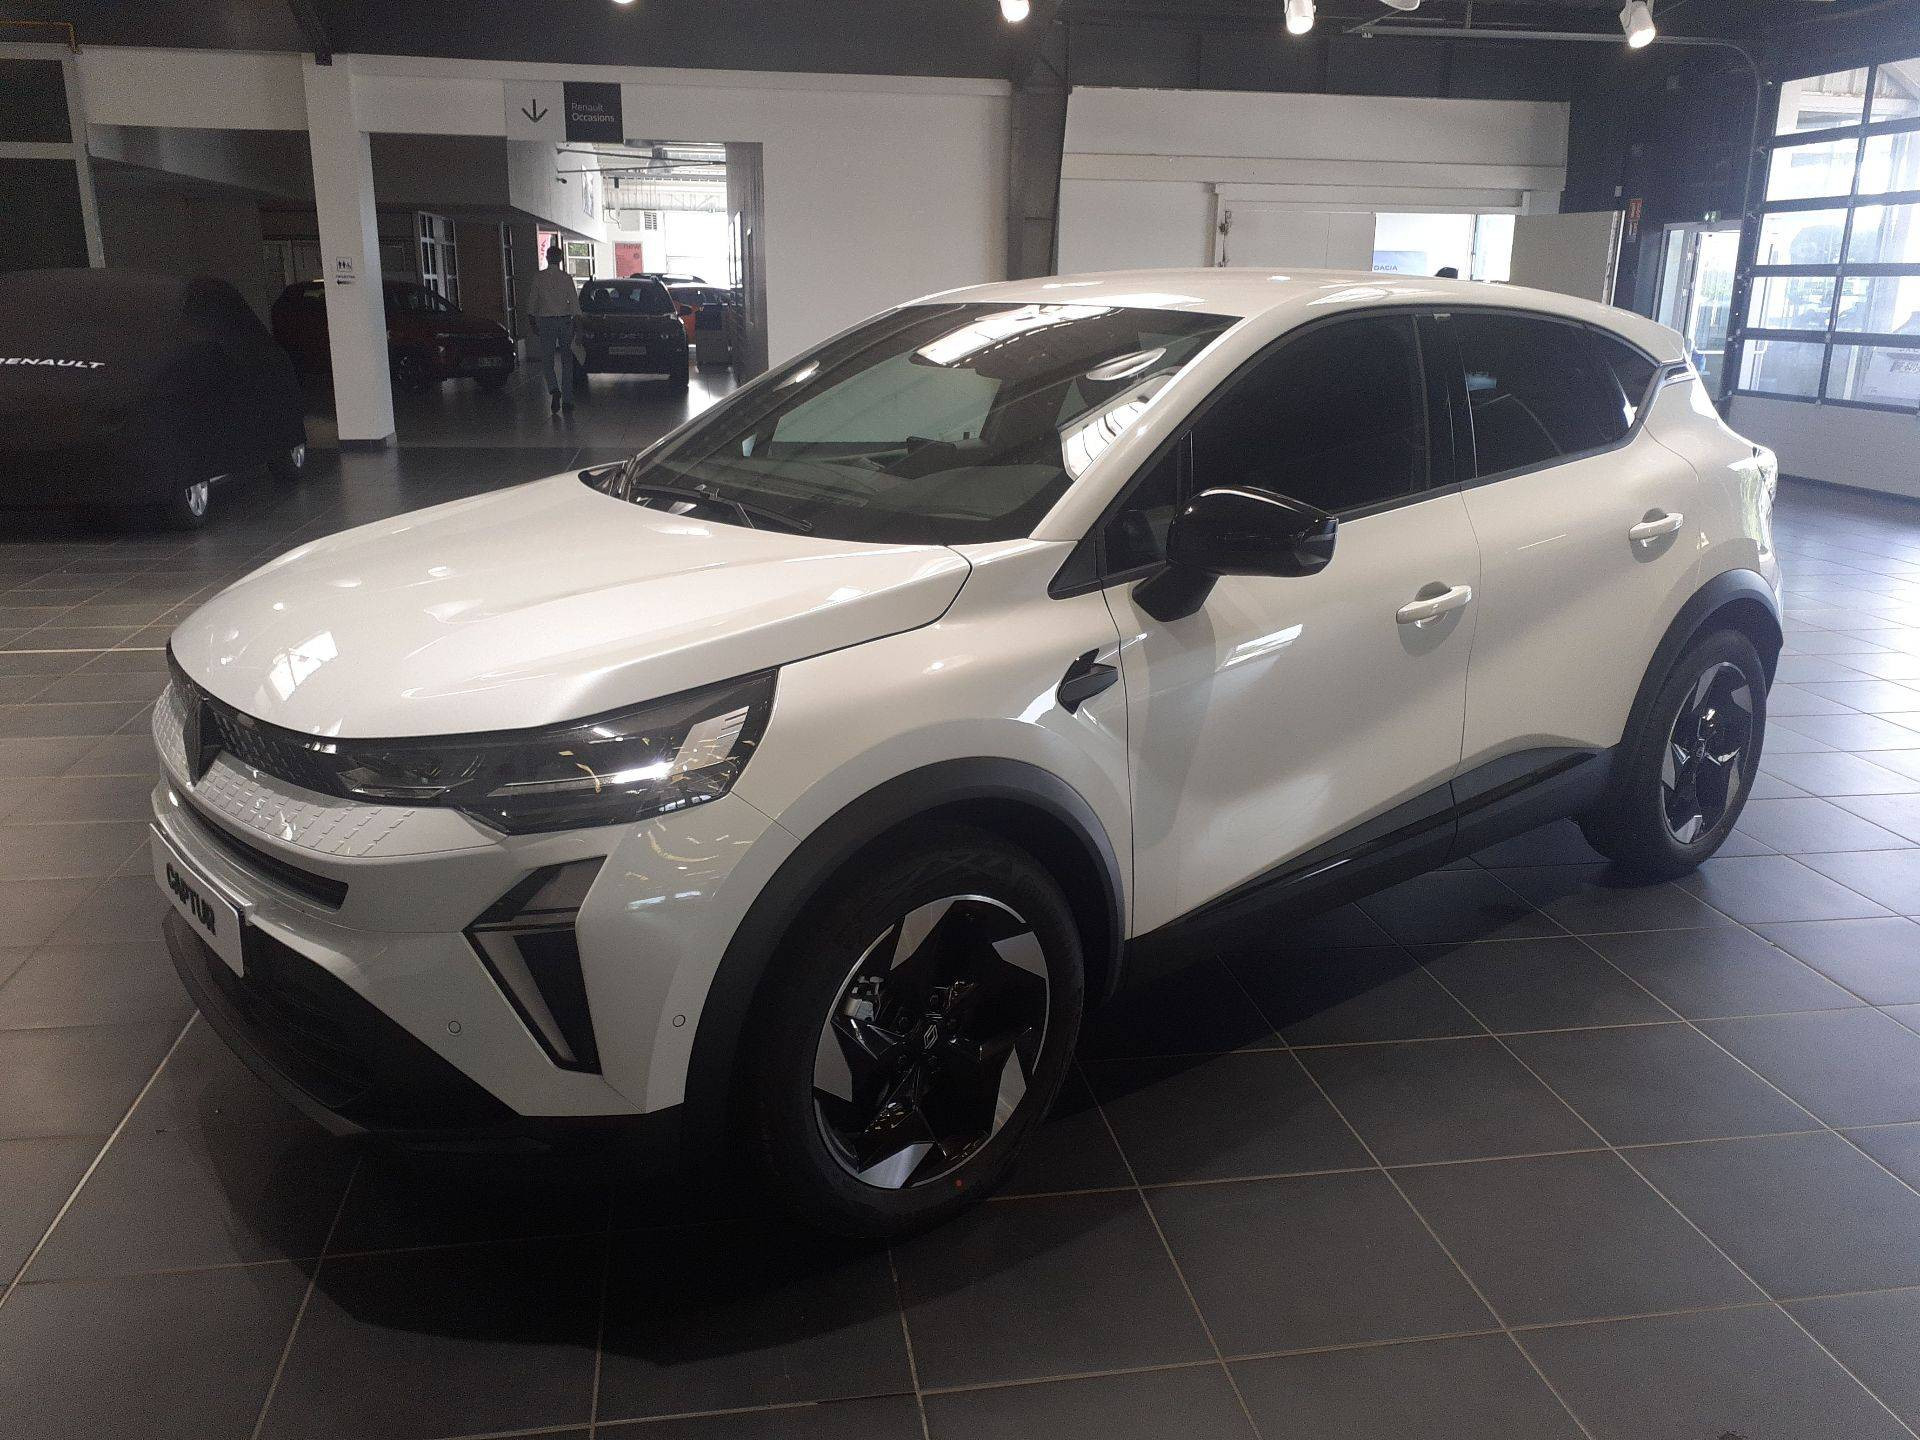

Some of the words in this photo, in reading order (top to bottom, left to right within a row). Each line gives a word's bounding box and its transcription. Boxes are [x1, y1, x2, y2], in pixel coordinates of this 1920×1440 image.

[571, 102, 604, 112] Renault
[571, 113, 615, 122] Occasions
[1373, 264, 1398, 272] DACIA
[166, 862, 217, 937] CAPTUR
